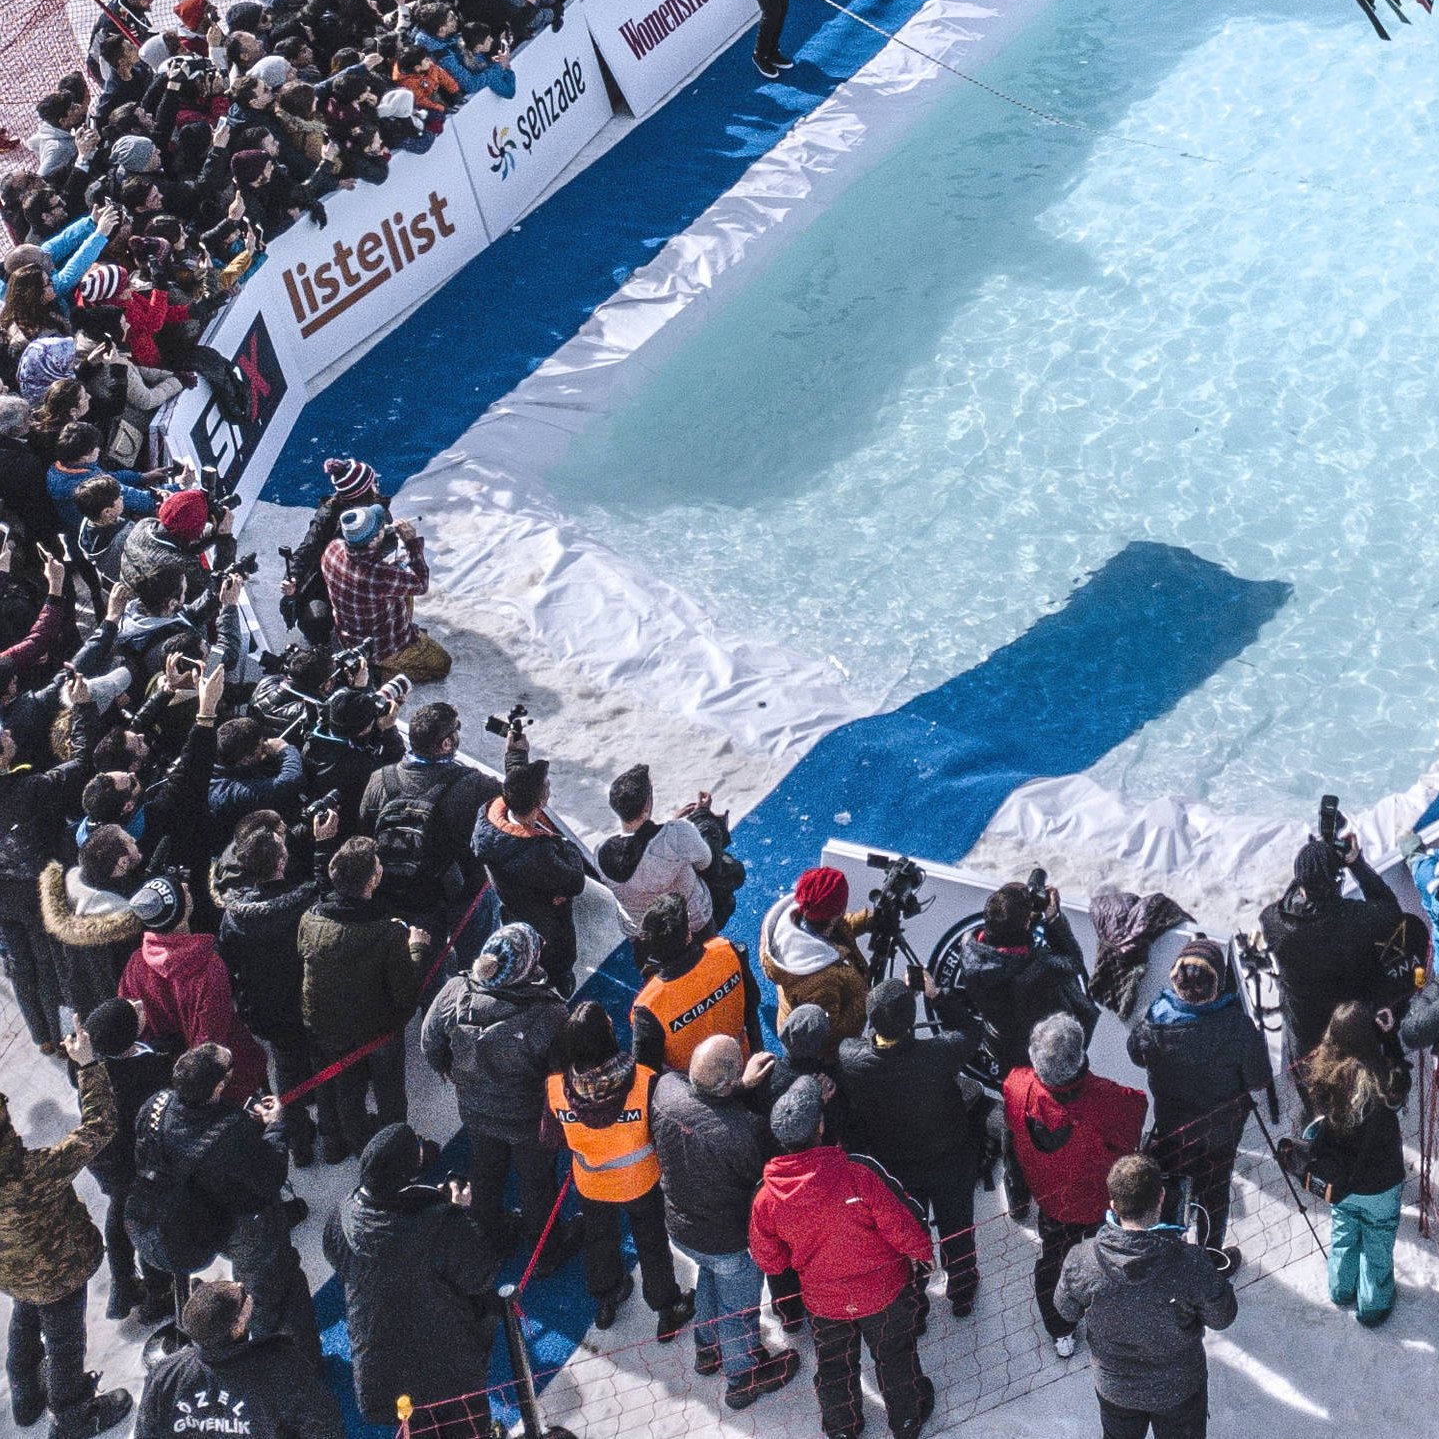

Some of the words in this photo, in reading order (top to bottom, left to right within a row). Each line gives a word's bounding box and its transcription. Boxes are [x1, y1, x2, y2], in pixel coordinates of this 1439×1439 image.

[517, 56, 586, 156] şehzade
[282, 191, 456, 325] listelist
[673, 972, 741, 1032] ACIBADEM
[173, 1415, 251, 1434] GÜVENLİK
[175, 1390, 245, 1417] ÖZEL
